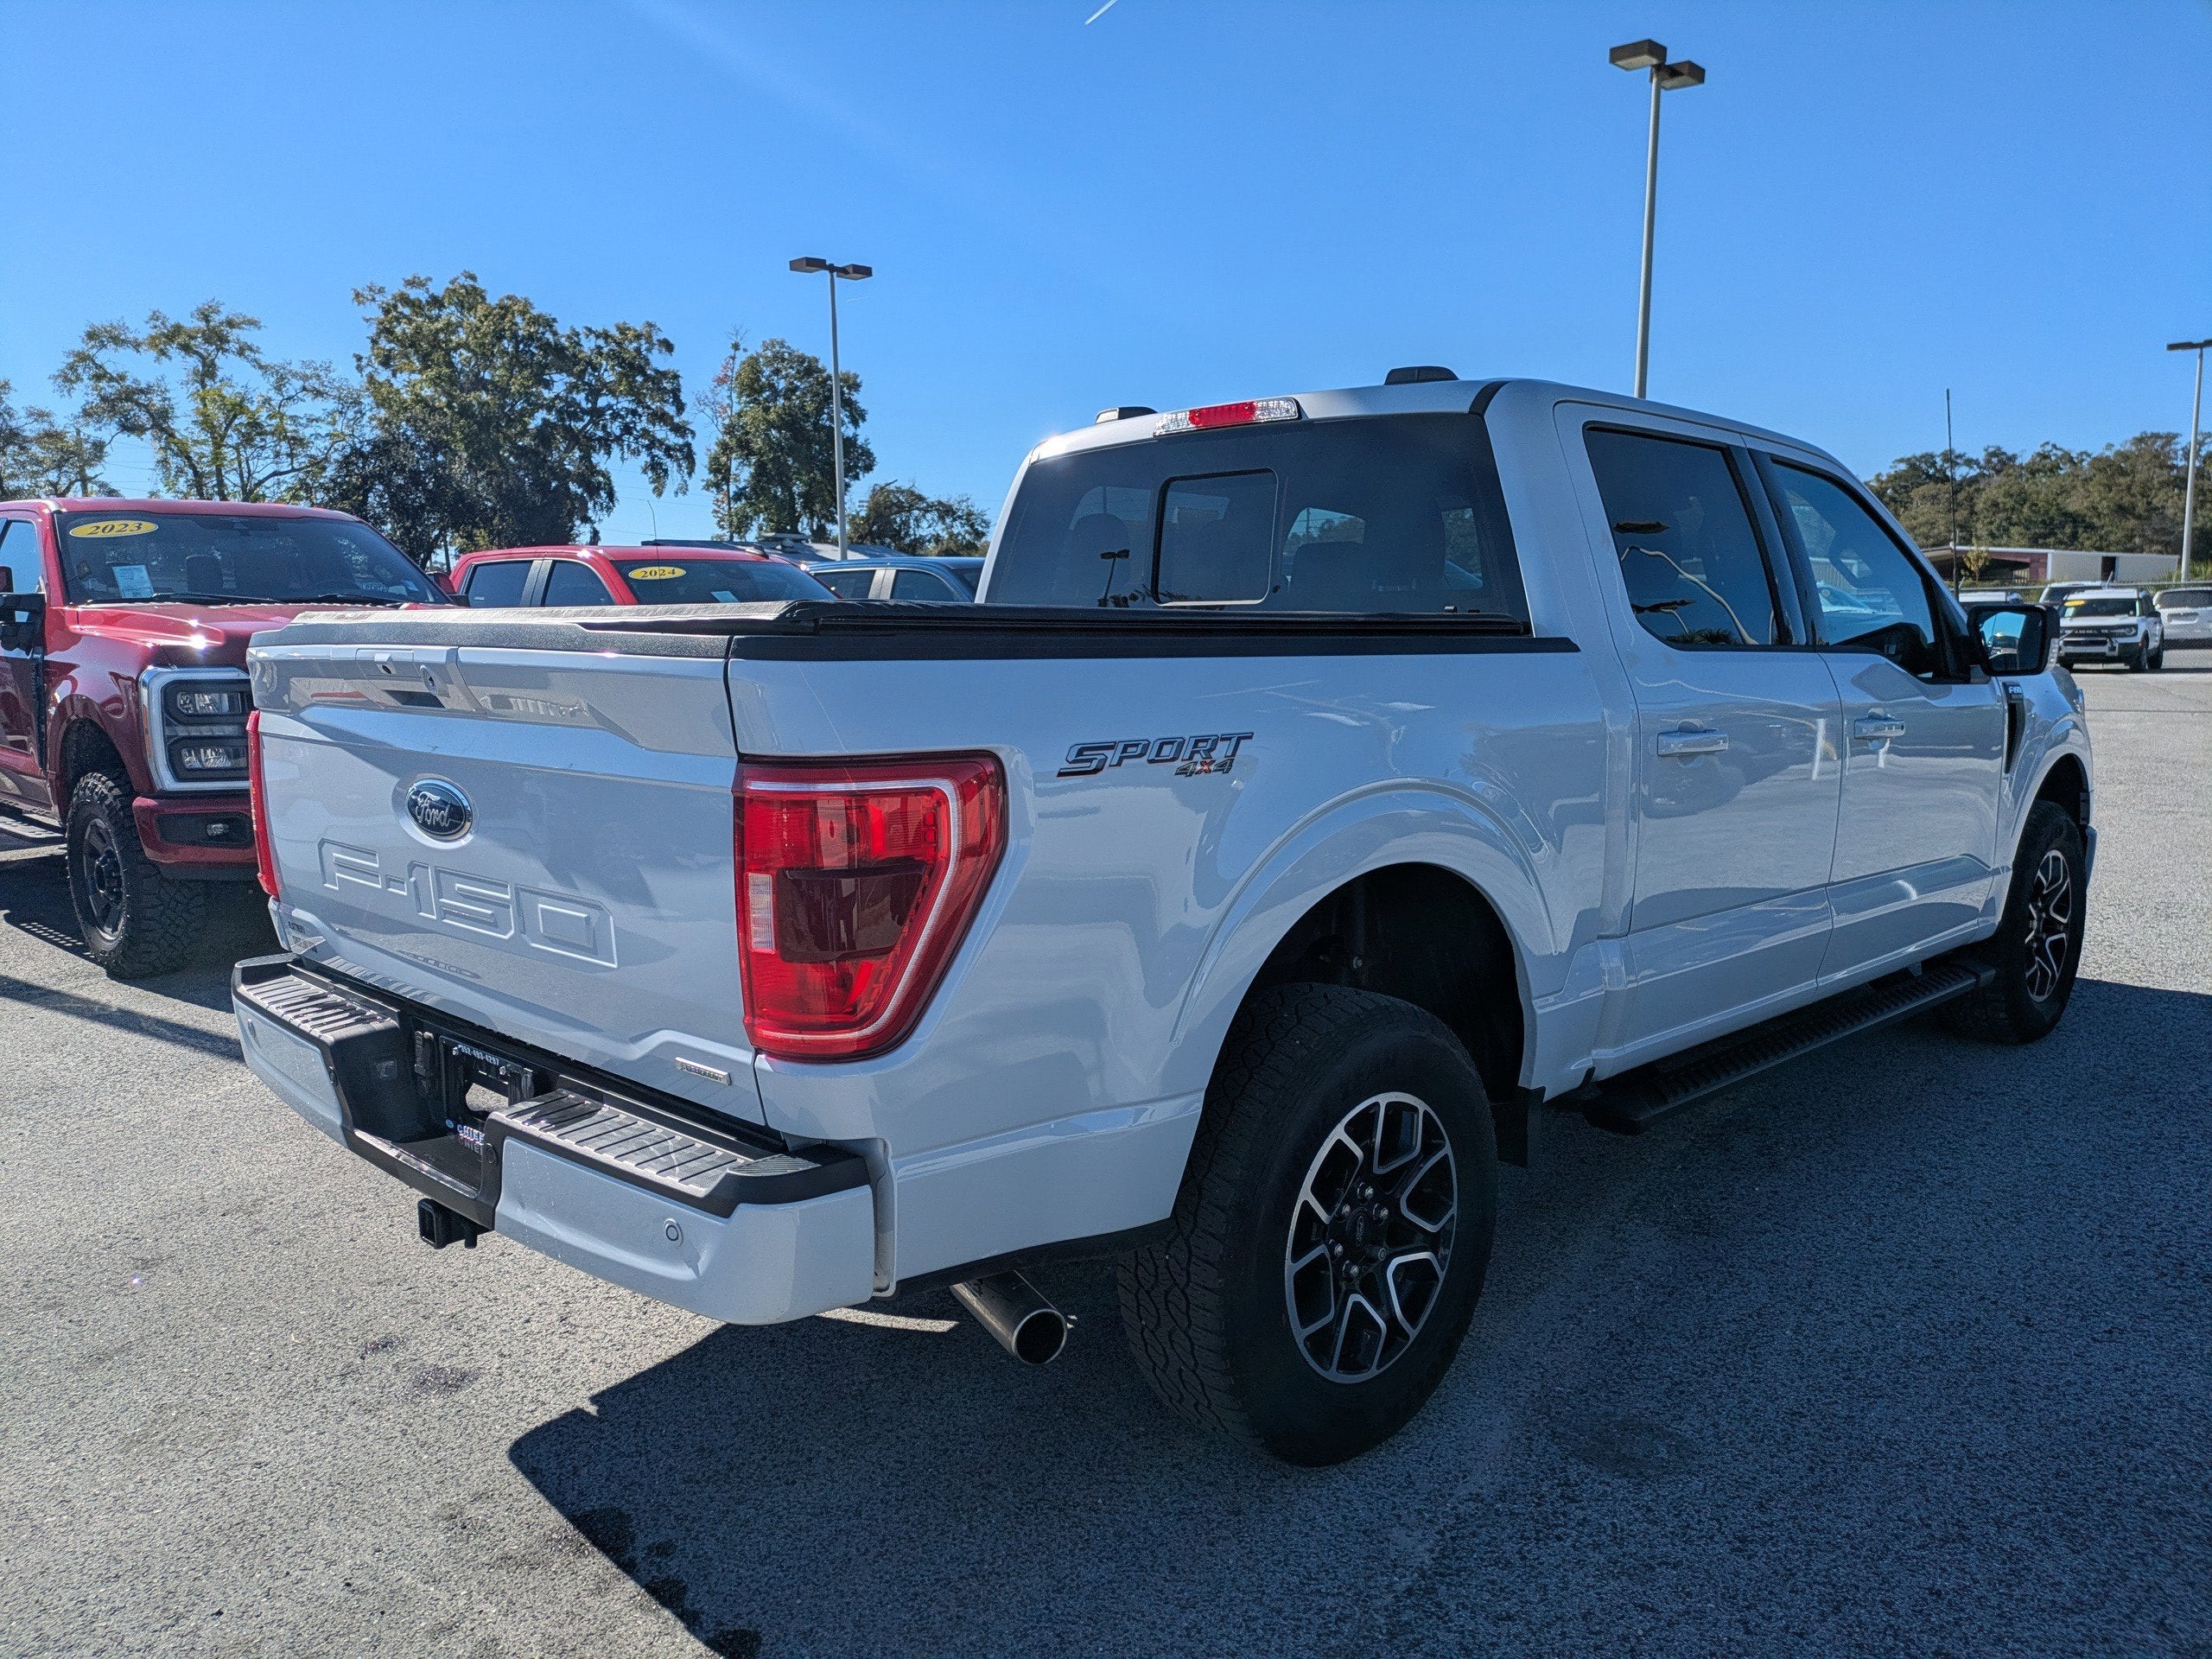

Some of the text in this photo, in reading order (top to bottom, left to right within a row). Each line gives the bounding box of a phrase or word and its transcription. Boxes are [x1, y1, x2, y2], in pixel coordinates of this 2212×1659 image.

[87, 522, 143, 536] 2023
[640, 568, 676, 578] 2024
[1056, 731, 1255, 778] SPORT
[411, 790, 458, 828] Ford
[317, 837, 619, 969] F-150
